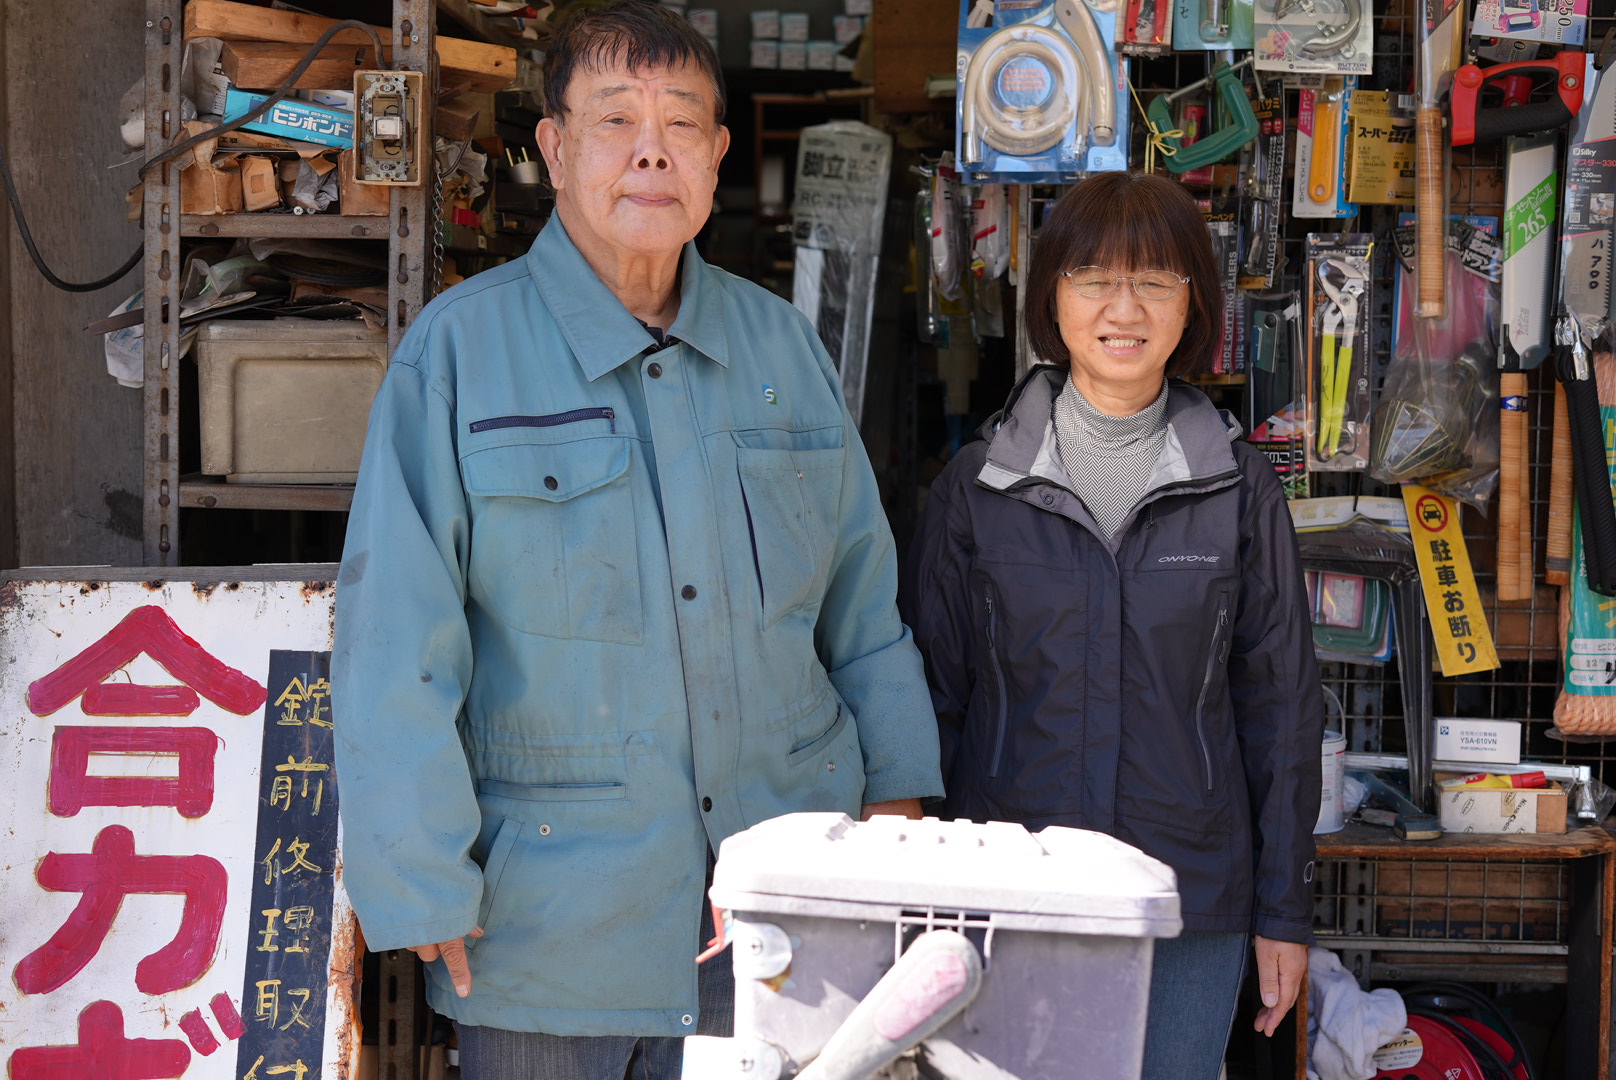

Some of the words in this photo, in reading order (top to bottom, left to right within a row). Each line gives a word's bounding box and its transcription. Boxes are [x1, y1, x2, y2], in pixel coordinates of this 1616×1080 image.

[272, 108, 353, 136] ヒシボンド
[1580, 148, 1597, 157] Silky
[1264, 213, 1278, 288] ALMIGHTY
[1271, 135, 1284, 207] SCISSORS
[1518, 207, 1547, 243] 265
[1227, 251, 1237, 290] PLIERS
[1224, 291, 1234, 344] CUTTING
[1223, 346, 1232, 369] SIDE
[1158, 555, 1220, 563] ONYONE
[1430, 539, 1477, 664] 駐車お断り
[1460, 737, 1497, 745] YSA-610VN
[1513, 798, 1527, 814] Nisso
